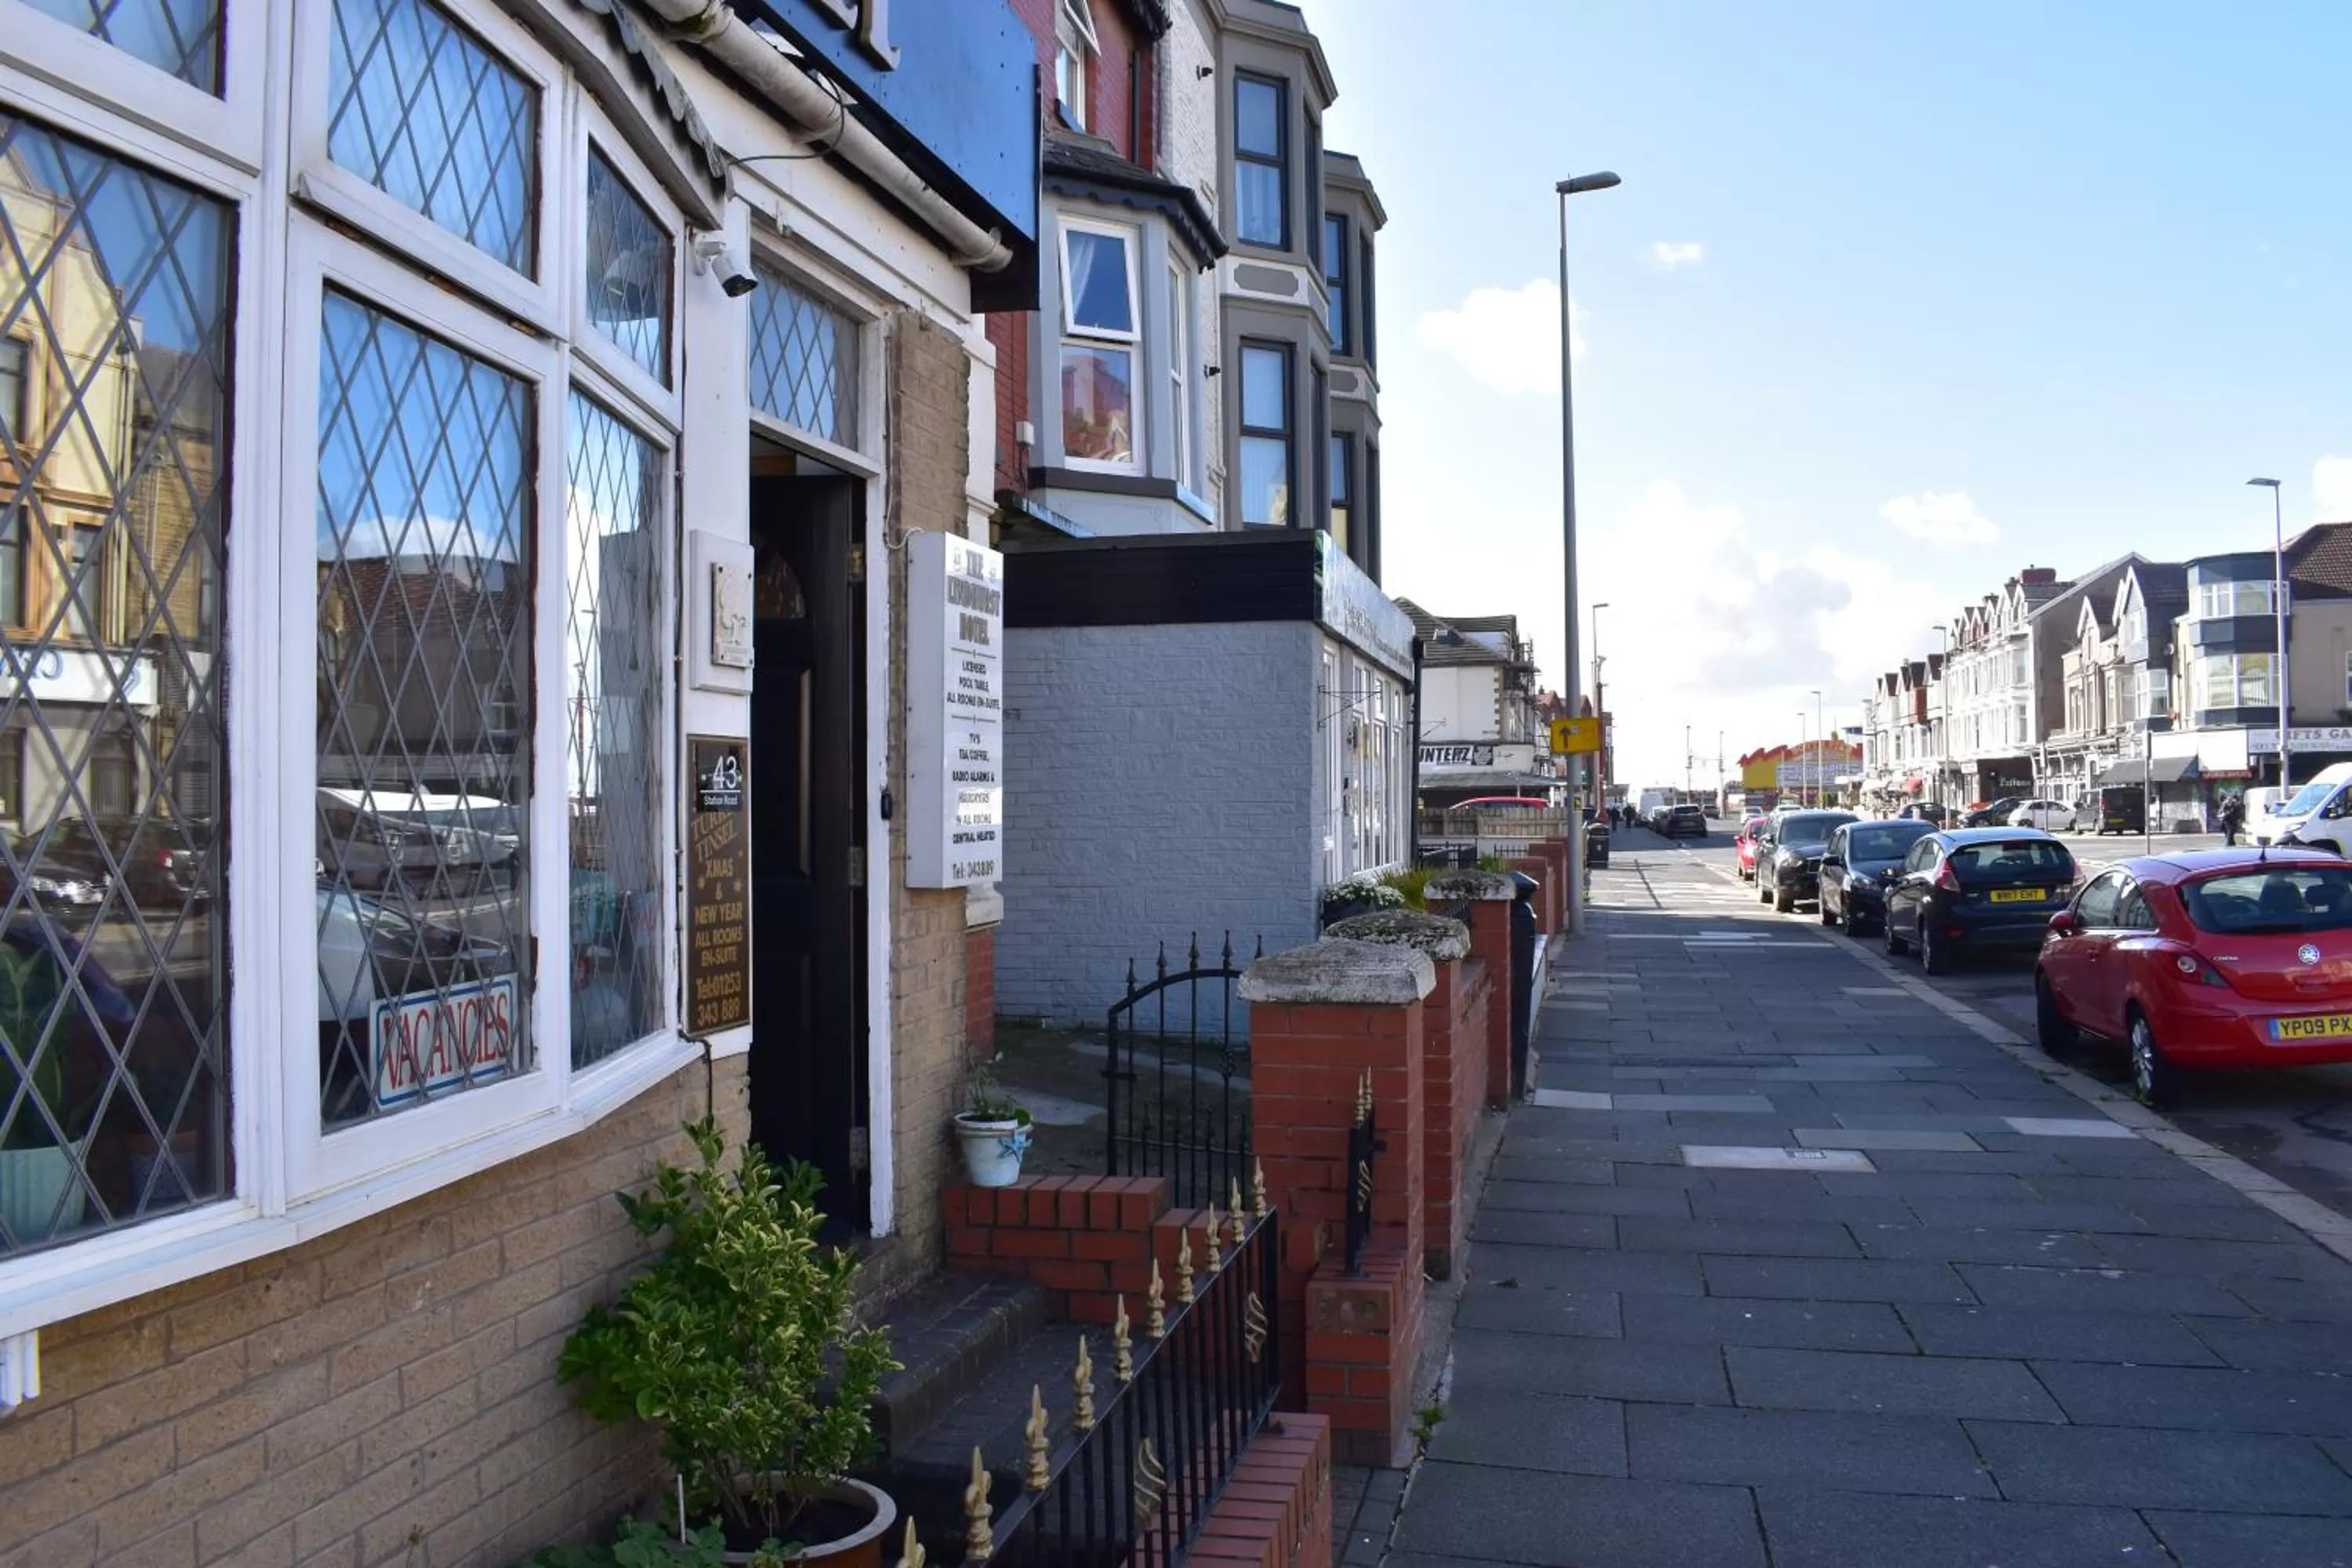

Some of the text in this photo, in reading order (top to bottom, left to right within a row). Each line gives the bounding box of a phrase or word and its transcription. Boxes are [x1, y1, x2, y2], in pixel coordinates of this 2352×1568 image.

[966, 549, 984, 581] THE
[713, 755, 737, 789] 43
[704, 795, 738, 805] Station Road
[706, 858, 733, 877] XMAS
[695, 902, 742, 925] NEW YEAR
[695, 926, 742, 949] ALL ROOMS
[2280, 1019, 2325, 1036] YP09
[383, 991, 508, 1090] VACANCIES
